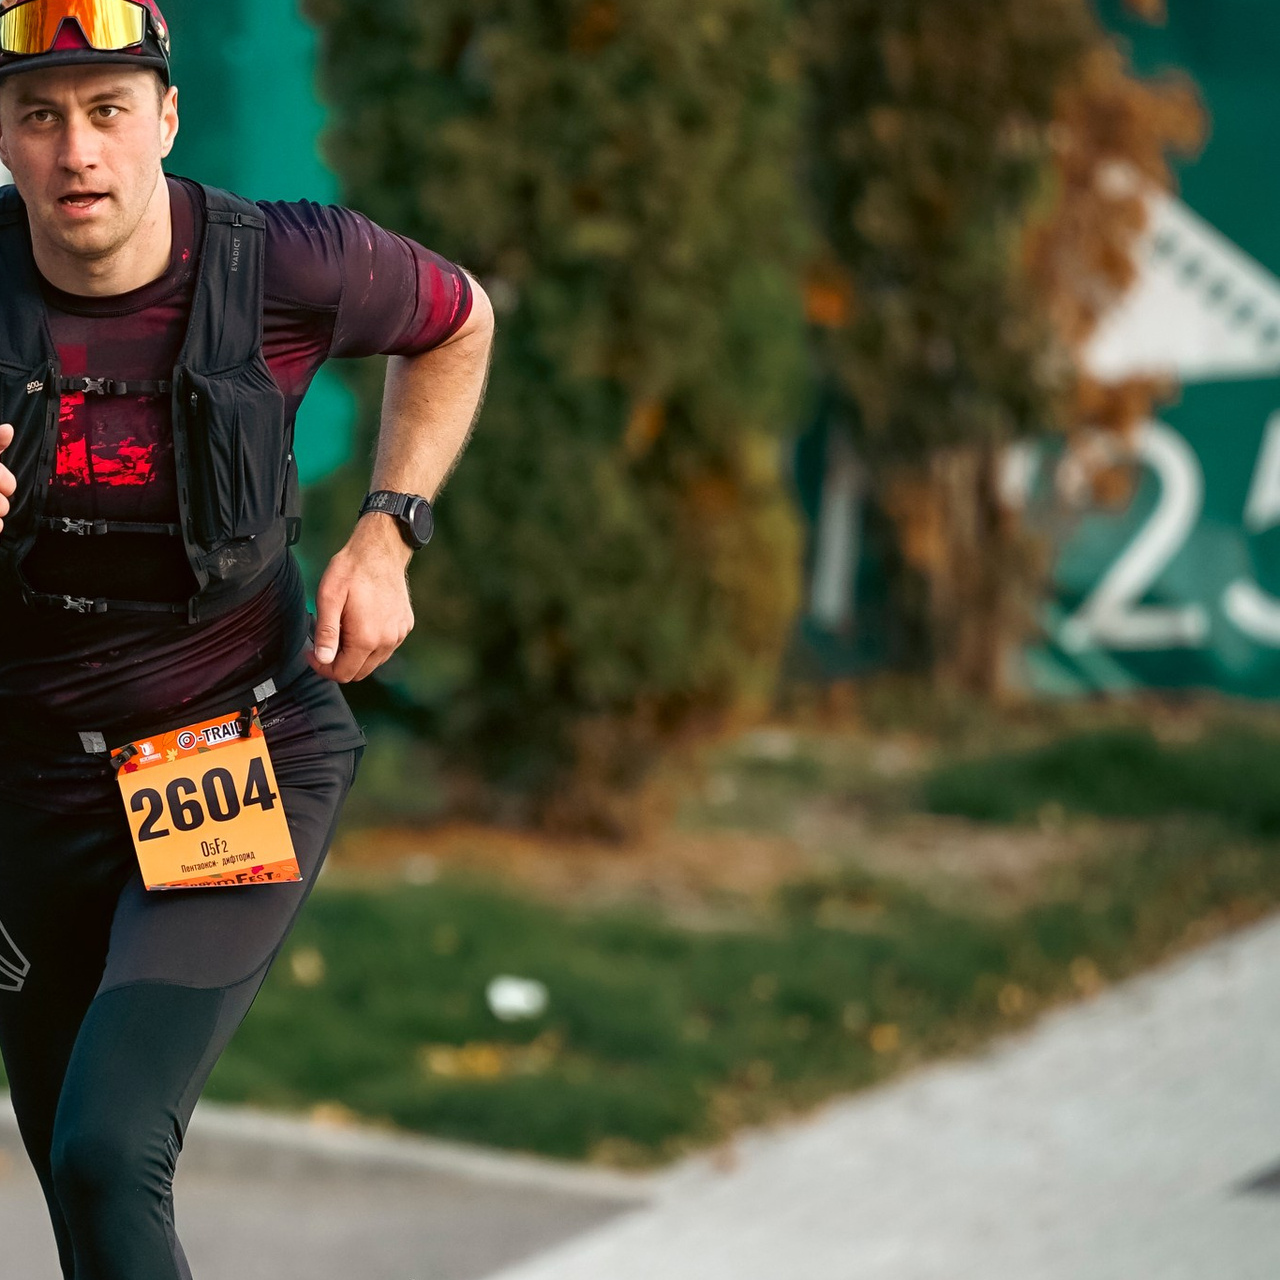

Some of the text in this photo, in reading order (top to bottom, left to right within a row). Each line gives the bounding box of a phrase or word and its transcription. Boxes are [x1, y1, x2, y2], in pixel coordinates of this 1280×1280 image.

[231, 237, 240, 272] EVADICT
[130, 756, 278, 842] 2604
[222, 851, 256, 867] дифторид
